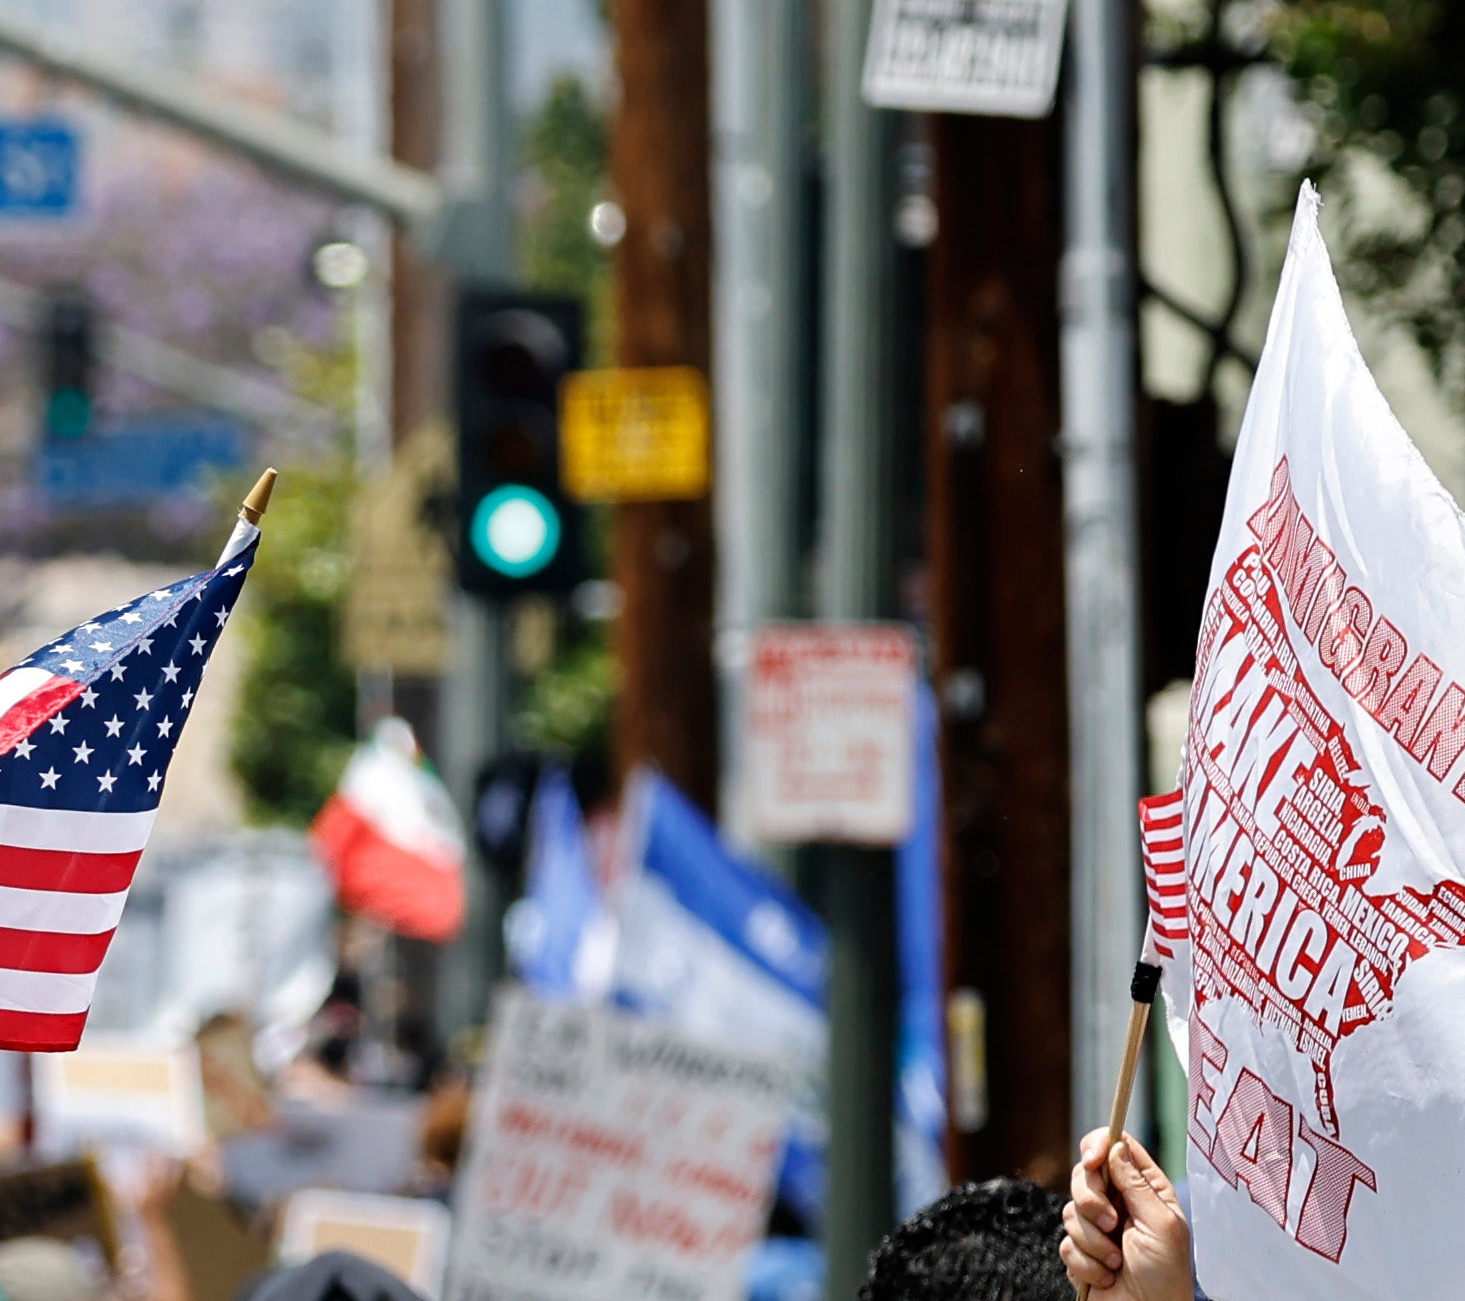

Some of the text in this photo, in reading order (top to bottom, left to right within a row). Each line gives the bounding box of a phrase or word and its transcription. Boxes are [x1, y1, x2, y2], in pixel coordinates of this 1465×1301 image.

[1292, 784, 1344, 850] ARGELIA,
[1309, 767, 1346, 820] SIRIA,
[1273, 829, 1312, 880] COSTA
[1308, 865, 1341, 909] RICA,
[1278, 801, 1332, 870] NICARAGUA,
[1339, 863, 1371, 881] CHINA
[1188, 1006, 1377, 1264] EAT
